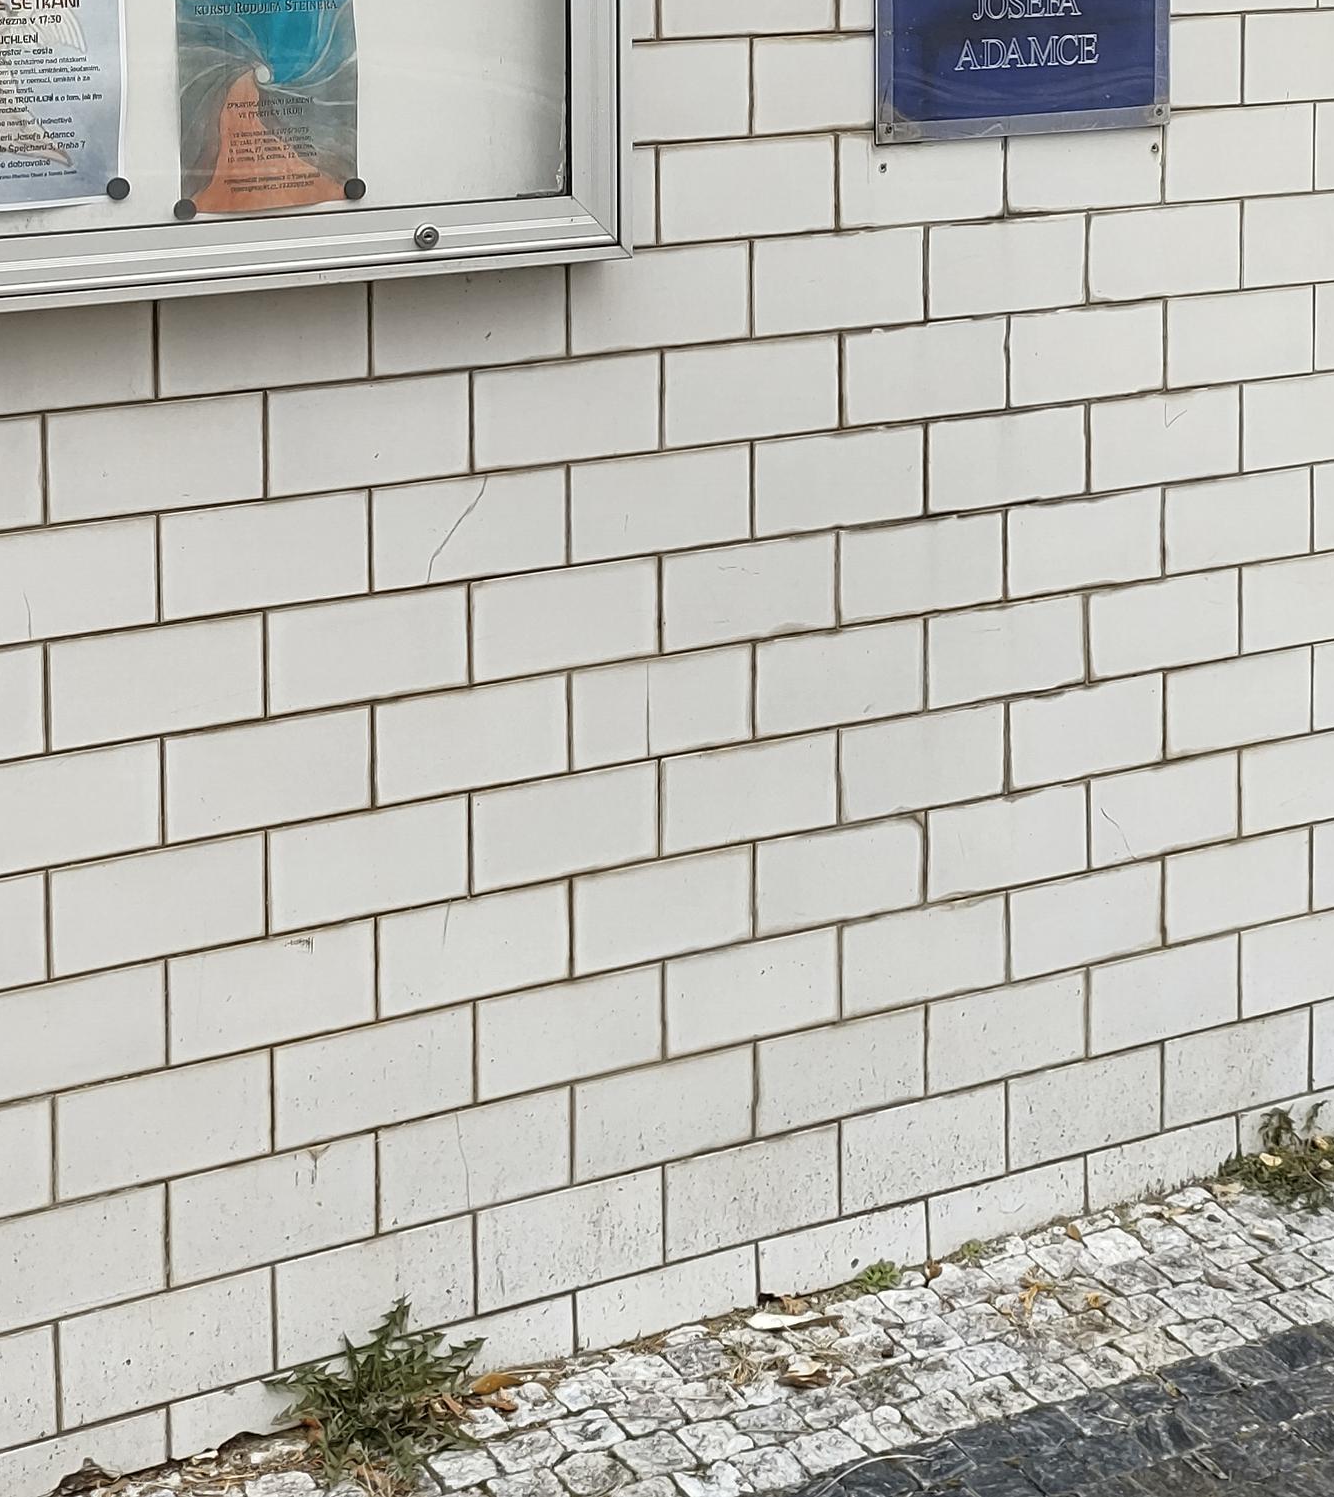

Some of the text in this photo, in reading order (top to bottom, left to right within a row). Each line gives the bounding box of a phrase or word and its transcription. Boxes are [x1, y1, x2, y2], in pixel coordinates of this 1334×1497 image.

[39, 15, 62, 24] 17:30
[954, 33, 1099, 72] ADAMCE
[80, 140, 85, 148] 7
[8, 159, 51, 168] dobrovolné
